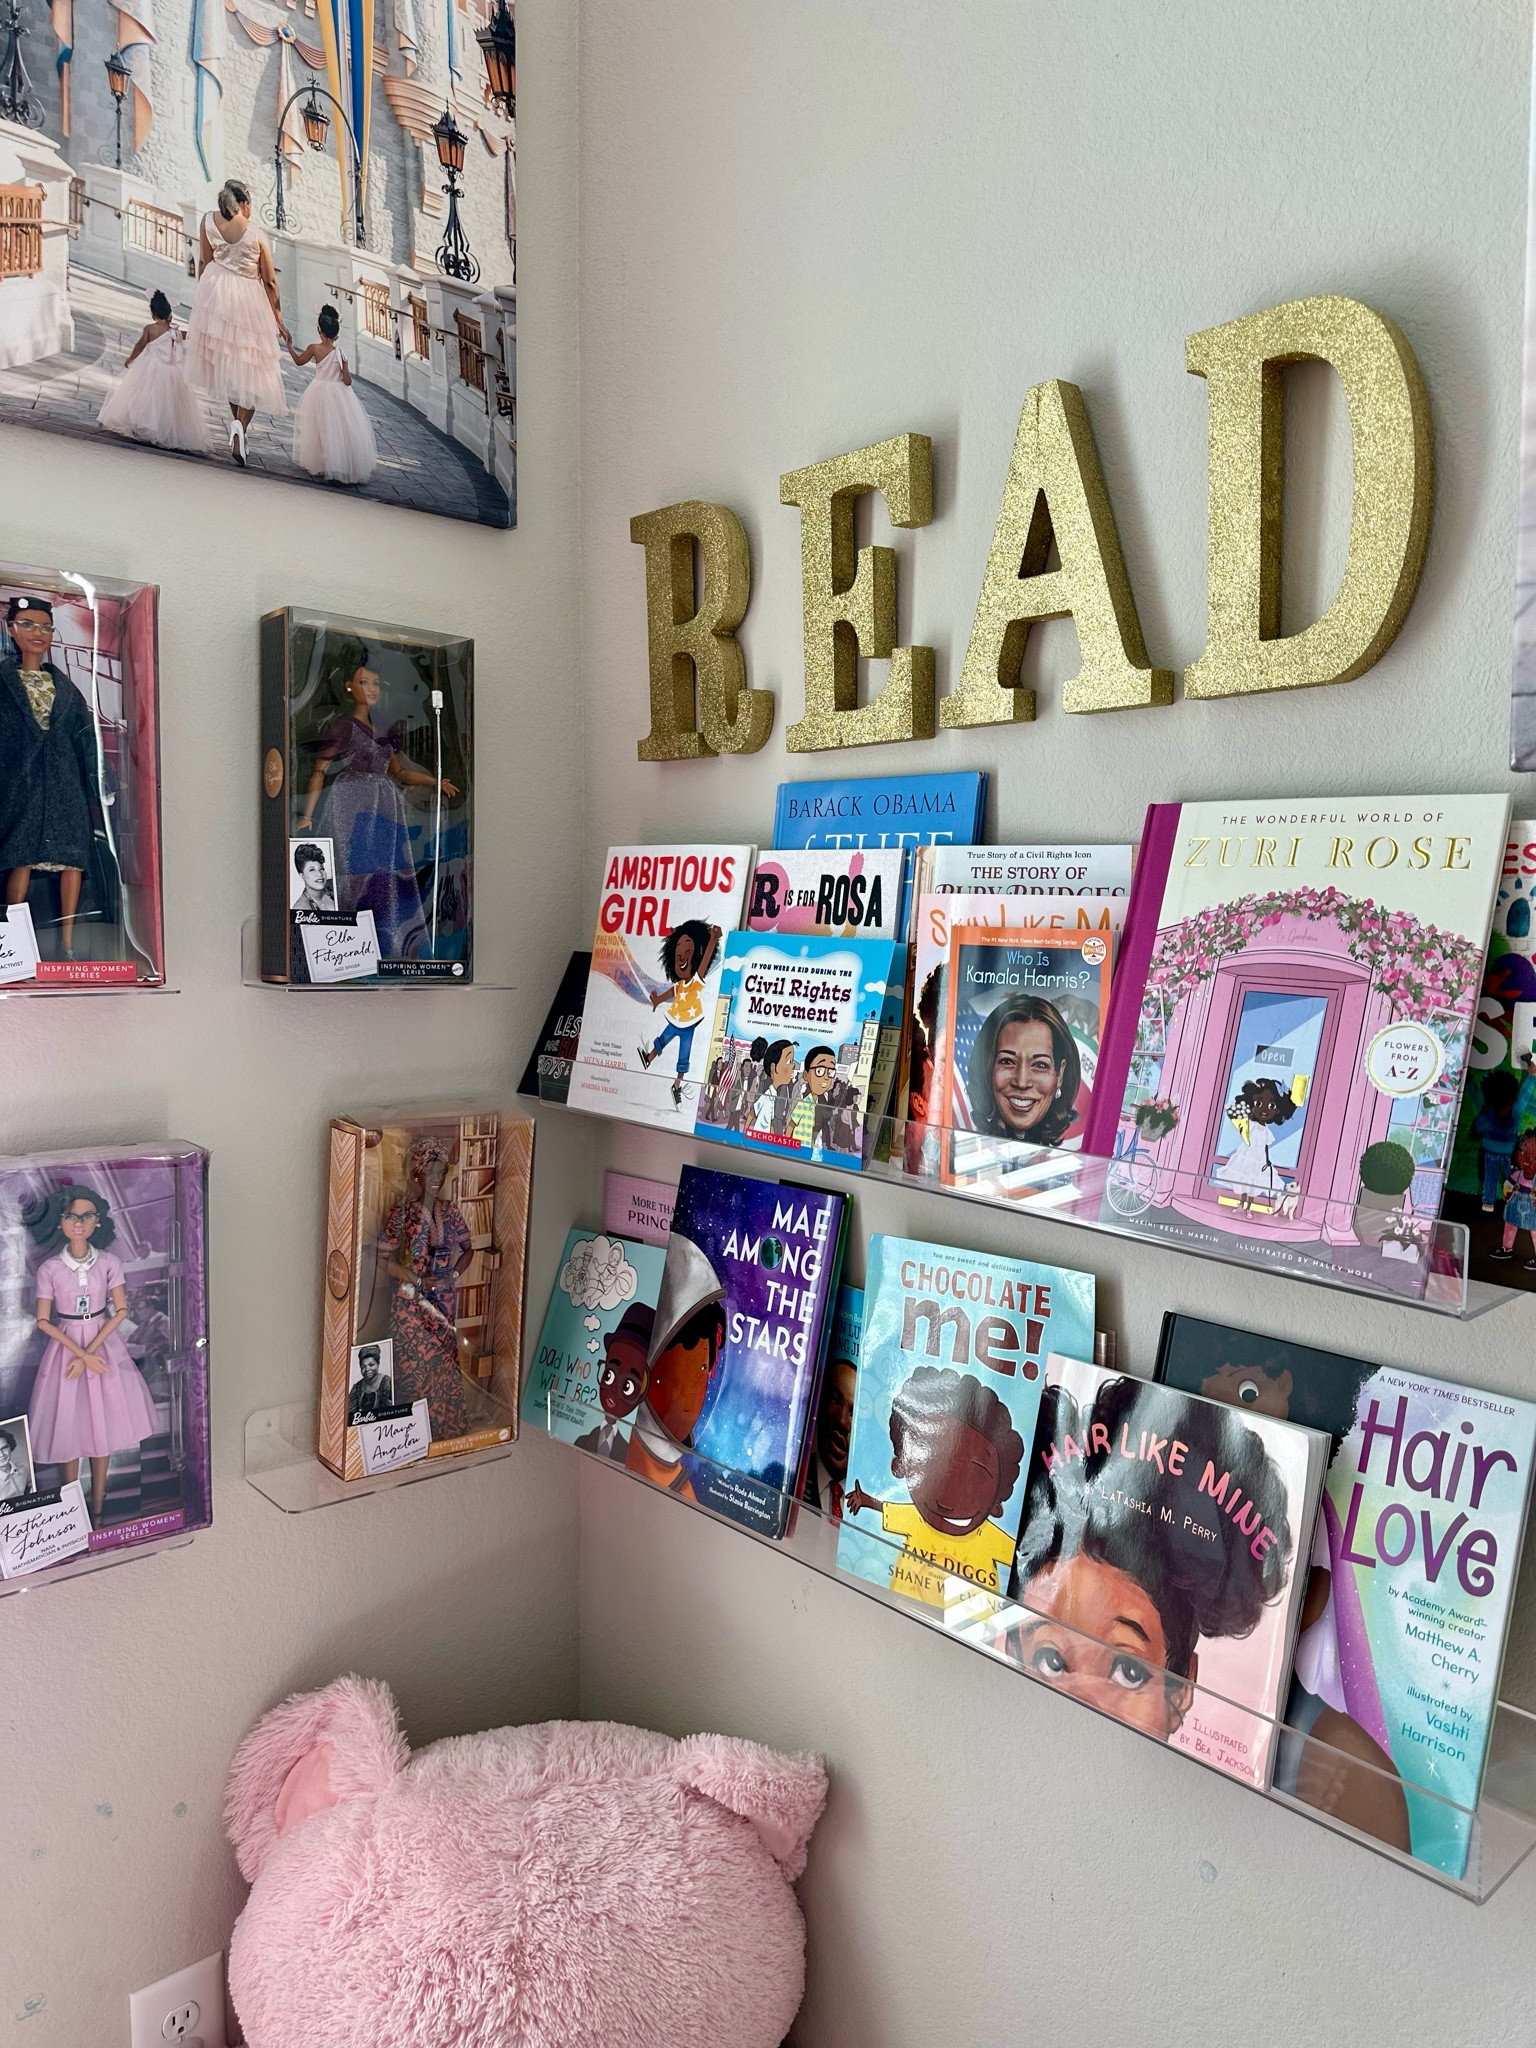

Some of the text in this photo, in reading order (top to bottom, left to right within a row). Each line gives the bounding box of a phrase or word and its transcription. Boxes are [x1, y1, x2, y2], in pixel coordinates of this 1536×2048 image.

[630, 294, 1435, 762] READ
[788, 791, 956, 819] BARACK OBAMA
[1222, 812, 1445, 825] THE WONDERFUL WORLD OF
[967, 851, 986, 859] True
[987, 851, 1007, 861] Story
[1009, 851, 1017, 859] of
[1026, 851, 1044, 859] Civil
[1046, 851, 1072, 860] Rights
[1074, 851, 1092, 859] Icon
[1184, 836, 1472, 871] ZURI ROSE
[605, 856, 737, 893] AMBITIOUS
[971, 866, 1088, 879] THE STORY OF
[750, 873, 882, 927] R IS FOR ROSA
[295, 911, 320, 924] Barbie
[601, 893, 673, 937] GIRL
[325, 929, 355, 946] Ella
[773, 964, 790, 972] WERE
[810, 967, 837, 976] DURING
[1007, 951, 1050, 966] Who Is
[745, 974, 852, 1003] Civil Rights
[966, 965, 1091, 989] Kamala Harris?
[748, 996, 838, 1023] Movement
[554, 1015, 582, 1038] LES
[611, 1042, 622, 1050] Times
[1261, 1049, 1286, 1063] Open
[1384, 1041, 1430, 1052] FLOWERS
[1391, 1052, 1418, 1063] FROM
[583, 1056, 627, 1070] MEENA HARRIS
[1385, 1064, 1419, 1081] A-Z
[752, 1131, 800, 1148] SCHOLASTIC
[632, 1195, 657, 1211] MORE
[771, 1199, 831, 1241] MAE
[722, 1228, 822, 1281] AMONG
[1129, 1217, 1373, 1279] MAKINI REGAL MARTIN ILLUSTRATED BY HALEY MOSS
[957, 1257, 976, 1266] sweet
[978, 1260, 989, 1268] and
[992, 1262, 1022, 1274] delicious!
[766, 1280, 817, 1324] THE
[900, 1260, 1051, 1318] CHOCOLATE
[729, 1312, 809, 1366] STARS
[900, 1296, 1045, 1381] me!
[558, 1378, 573, 1399] I
[1379, 1375, 1516, 1416] A NEW YORK TIMES BESTSELLER
[374, 1421, 416, 1441] Maya
[372, 1434, 420, 1460] Angelou
[1357, 1395, 1518, 1510] Hair
[15, 1494, 56, 1507] SIGNATURE
[734, 1484, 766, 1506] Roda Ahmed
[1042, 1422, 1277, 1561] HAIR LIKE MINE
[744, 1501, 771, 1520] Burrington
[1160, 1506, 1175, 1524] M.
[0, 1506, 80, 1542] Katherine
[92, 1525, 138, 1541] INSPIRING
[119, 1529, 150, 1541] SERIES
[11, 1524, 77, 1559] Johnson
[12, 1535, 87, 1571] MATHEMATICIAN PHYSICIST
[41, 1544, 56, 1553] NASA
[888, 1565, 931, 1589] SHANE
[944, 1557, 997, 1587] DIGGS
[1388, 1585, 1446, 1615] by Academy
[1408, 1608, 1486, 1641] winning creator
[1405, 1622, 1482, 1663] Matthew A.
[1431, 1653, 1480, 1684] Cherry
[1406, 1685, 1473, 1722] illustrated by
[1180, 1733, 1190, 1744] BY
[1426, 1711, 1470, 1741] Vashti
[1401, 1722, 1466, 1762] Harrison
